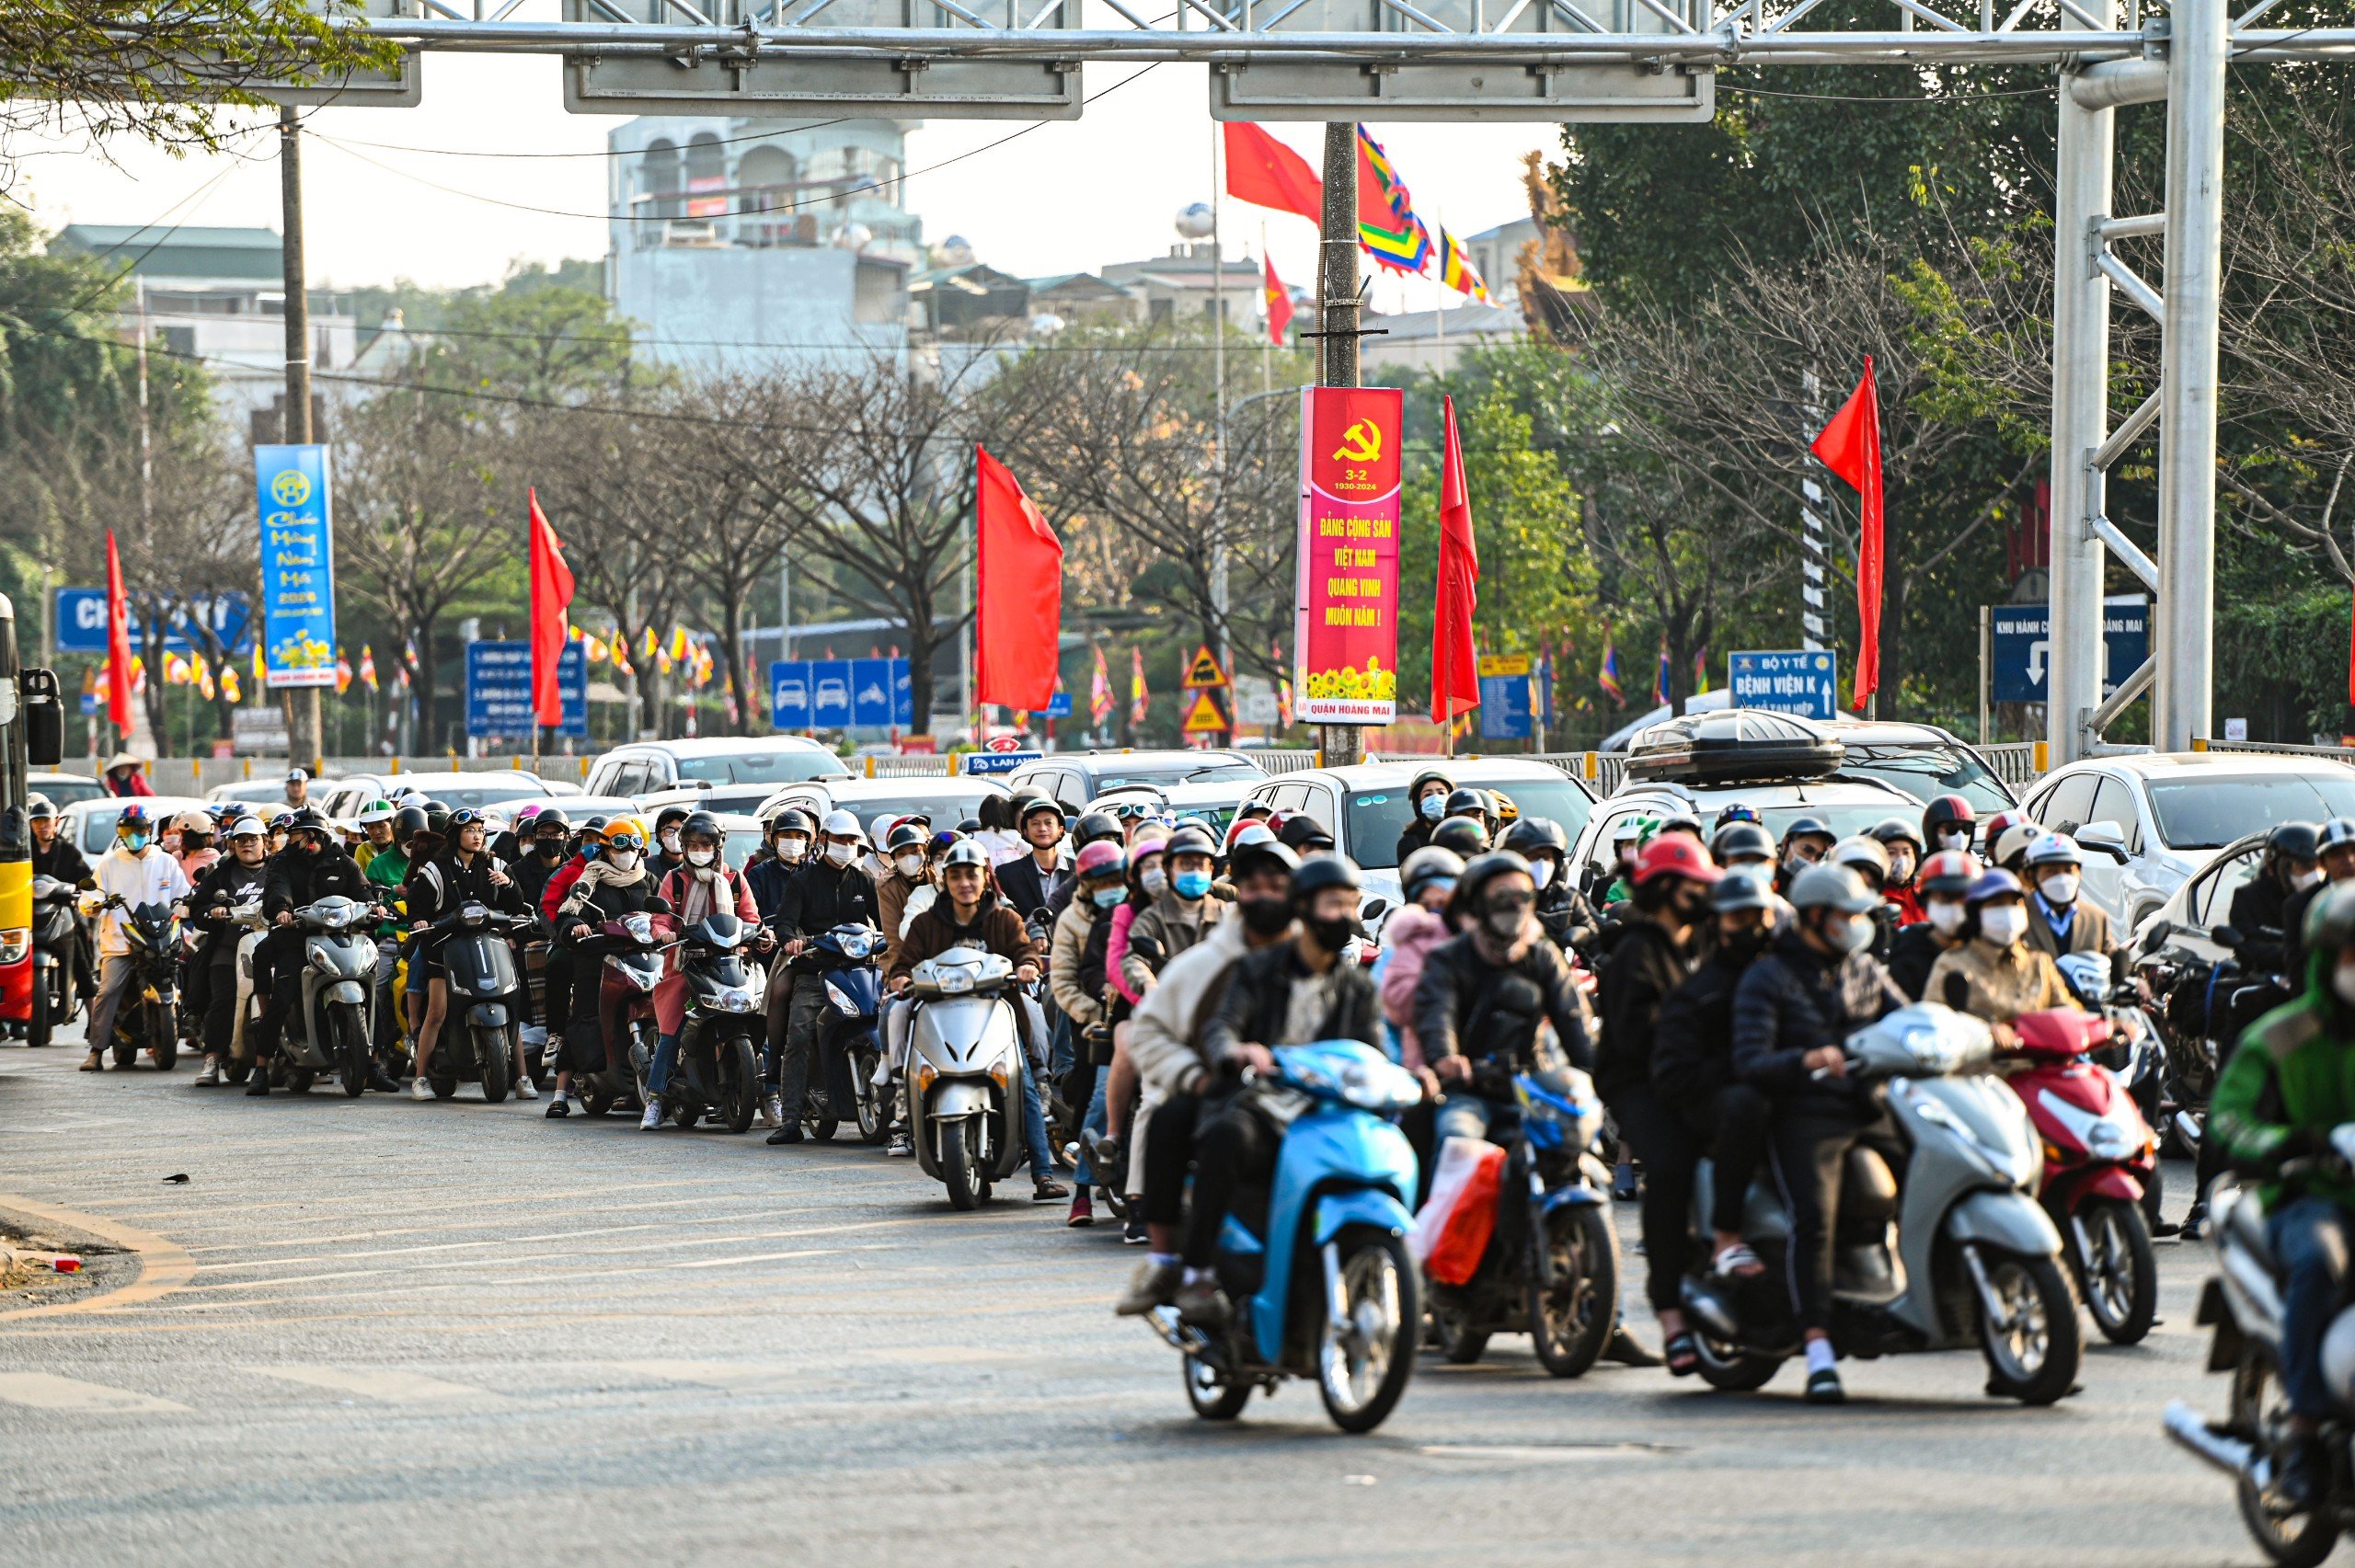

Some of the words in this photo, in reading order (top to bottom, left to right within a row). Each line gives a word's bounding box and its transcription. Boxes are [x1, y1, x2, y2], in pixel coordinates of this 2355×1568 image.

[1345, 469, 1367, 481] 3-2
[1320, 510, 1344, 537] ĐẢNG
[1346, 515, 1371, 541] CỘNG
[1373, 512, 1392, 538] SẢN
[1335, 544, 1353, 570] VIỆT
[1355, 549, 1376, 567] NAM
[1327, 578, 1358, 598] QUANG
[1360, 578, 1381, 597] VINH
[1325, 603, 1352, 626] MUÔN
[1354, 604, 1375, 626] NĂM
[1996, 621, 2015, 634] KHU
[2016, 618, 2039, 634] HÀNH
[2103, 617, 2124, 633] ÀNG
[2125, 619, 2142, 633] MAI
[1762, 655, 1780, 671] BỘ
[1782, 658, 1790, 670] Y
[1792, 654, 1809, 670] TẾ
[1736, 673, 1771, 698] BỆNH
[1774, 673, 1804, 698] VIỆN
[1806, 676, 1816, 693] K
[1311, 704, 1336, 715] QUẬN
[1338, 704, 1370, 715] HOÀNG
[1373, 706, 1390, 715] MAI
[992, 759, 1015, 767] LAN
